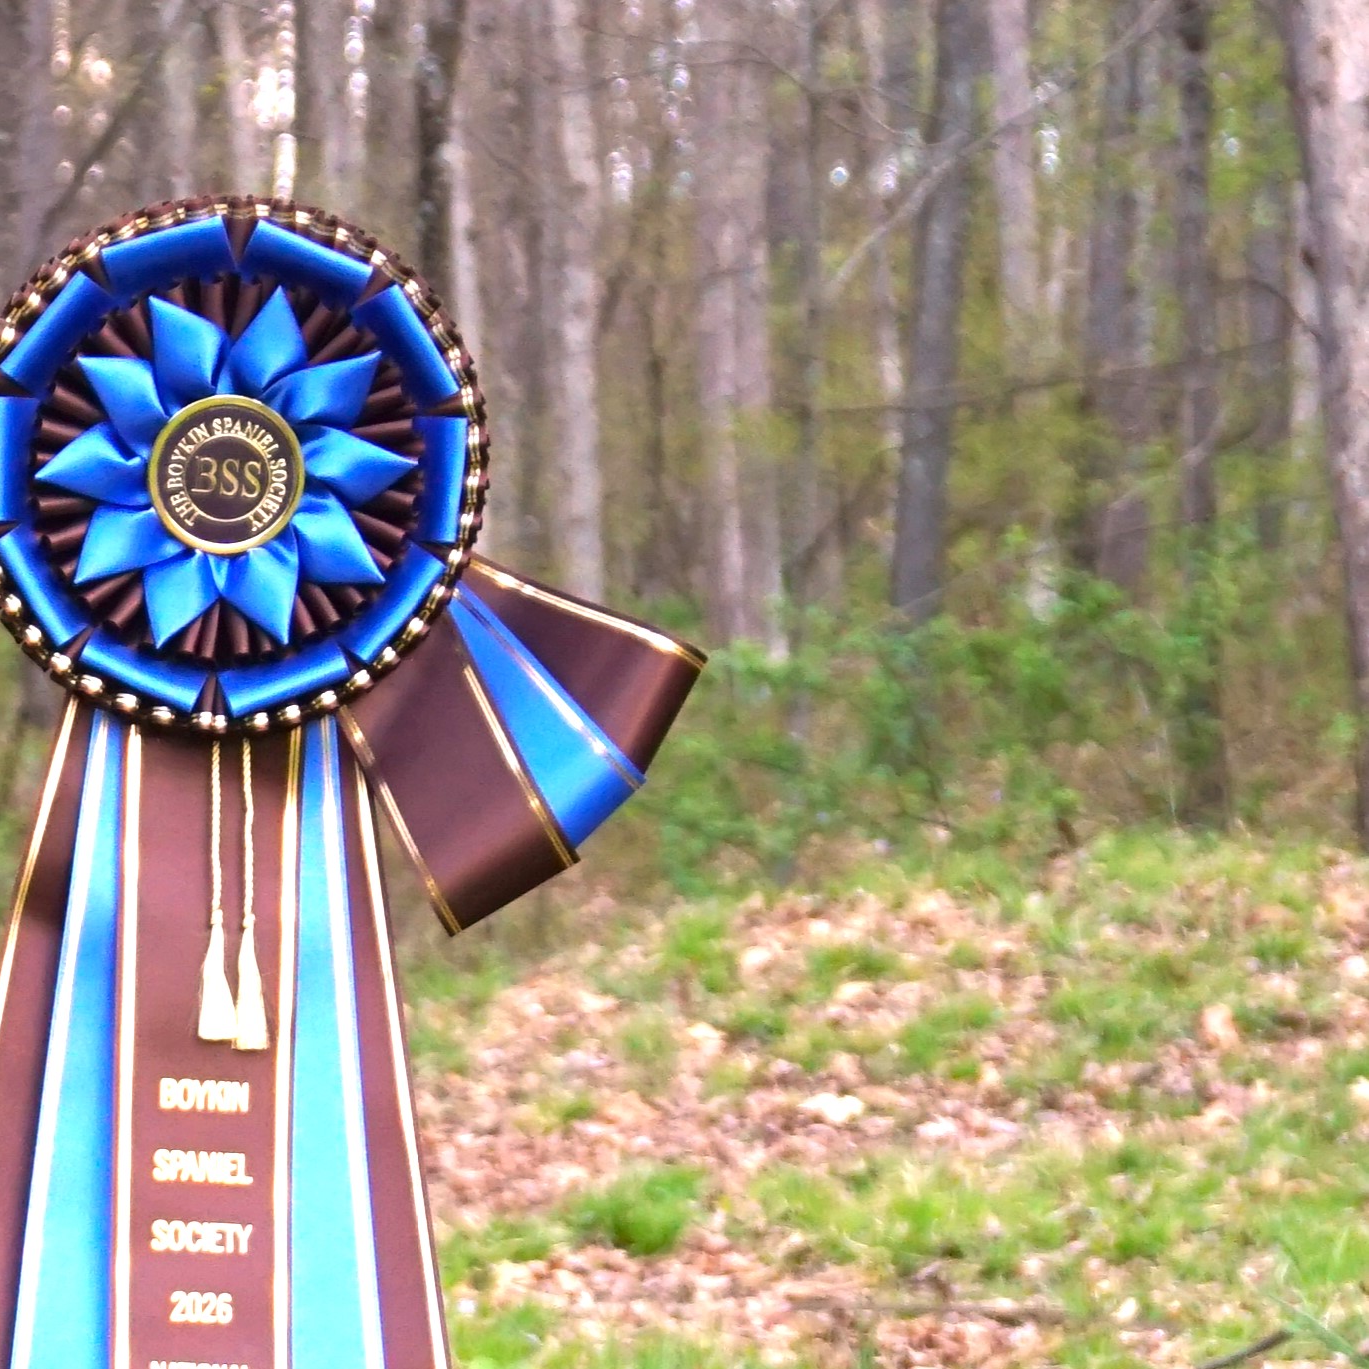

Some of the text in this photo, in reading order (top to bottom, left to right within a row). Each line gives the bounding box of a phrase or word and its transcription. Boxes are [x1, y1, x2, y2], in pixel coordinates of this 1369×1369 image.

[167, 416, 288, 532] THE BOYKIN SPANIEL SOCIETY
[190, 455, 262, 499] BSS
[159, 1077, 250, 1114] BOYKIN
[152, 1148, 254, 1186] SPANIEL
[150, 1218, 254, 1256] SOCIETY
[169, 1290, 234, 1326] 2026
